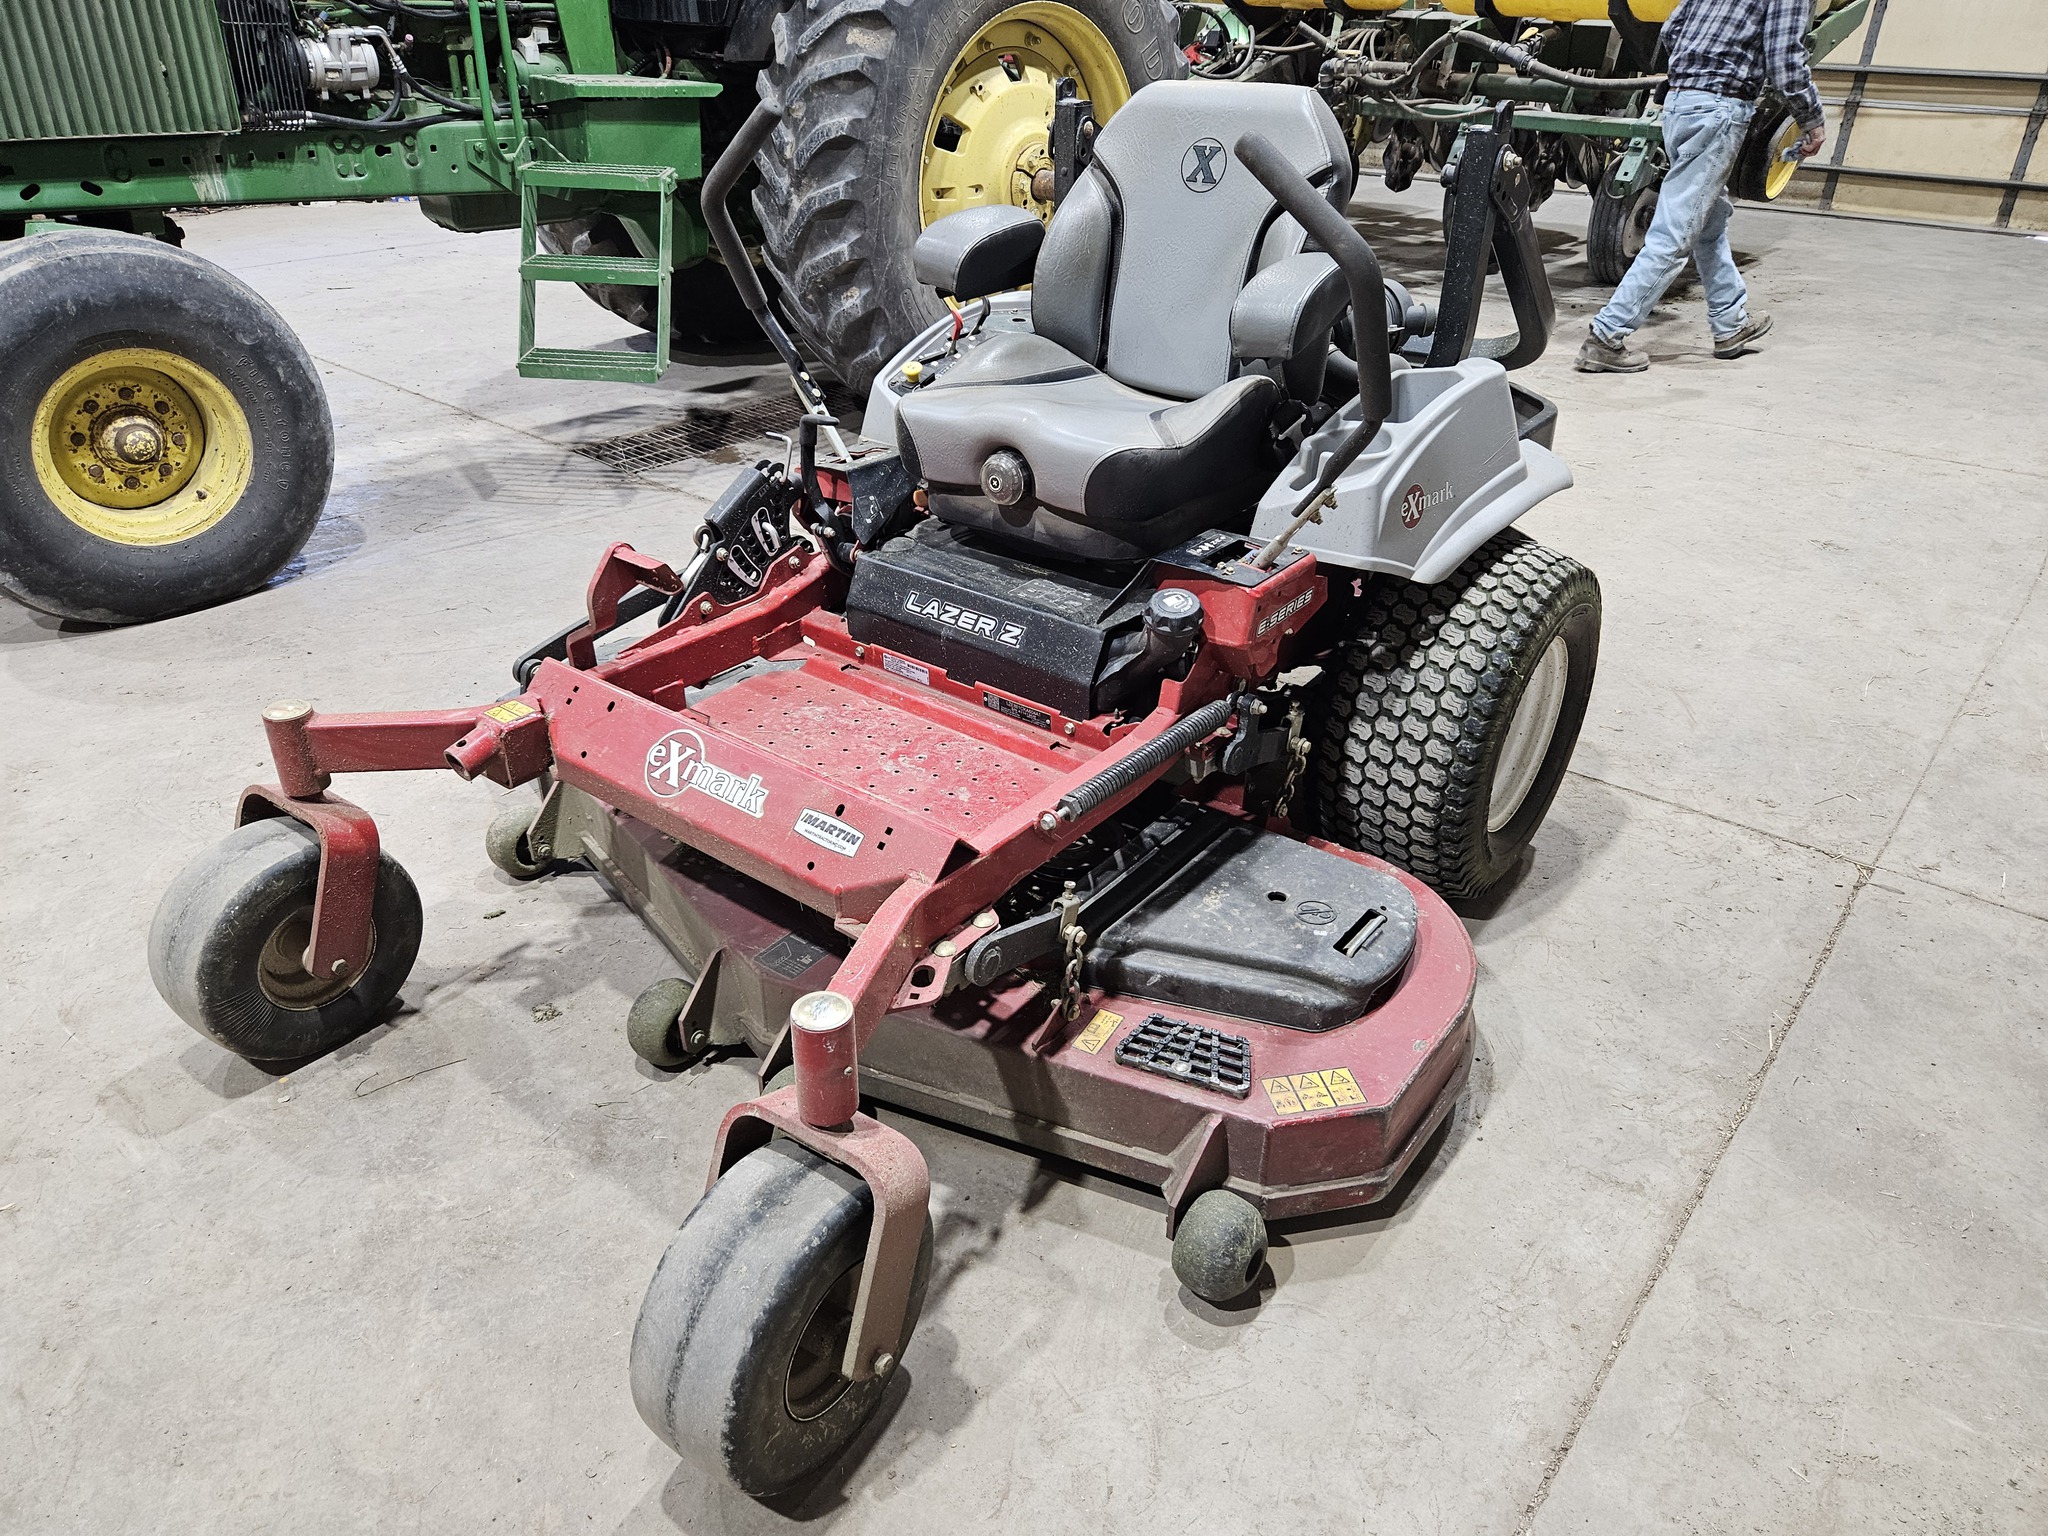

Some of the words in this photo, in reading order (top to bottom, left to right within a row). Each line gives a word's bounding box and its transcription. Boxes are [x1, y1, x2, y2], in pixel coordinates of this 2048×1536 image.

[1185, 144, 1222, 185] X
[1400, 481, 1454, 523] eXmark
[904, 590, 999, 641] LAZER
[997, 620, 1026, 648] Z
[1257, 588, 1315, 637] E-SERIES
[648, 737, 767, 815] eXmark
[802, 813, 861, 846] MARTIN
